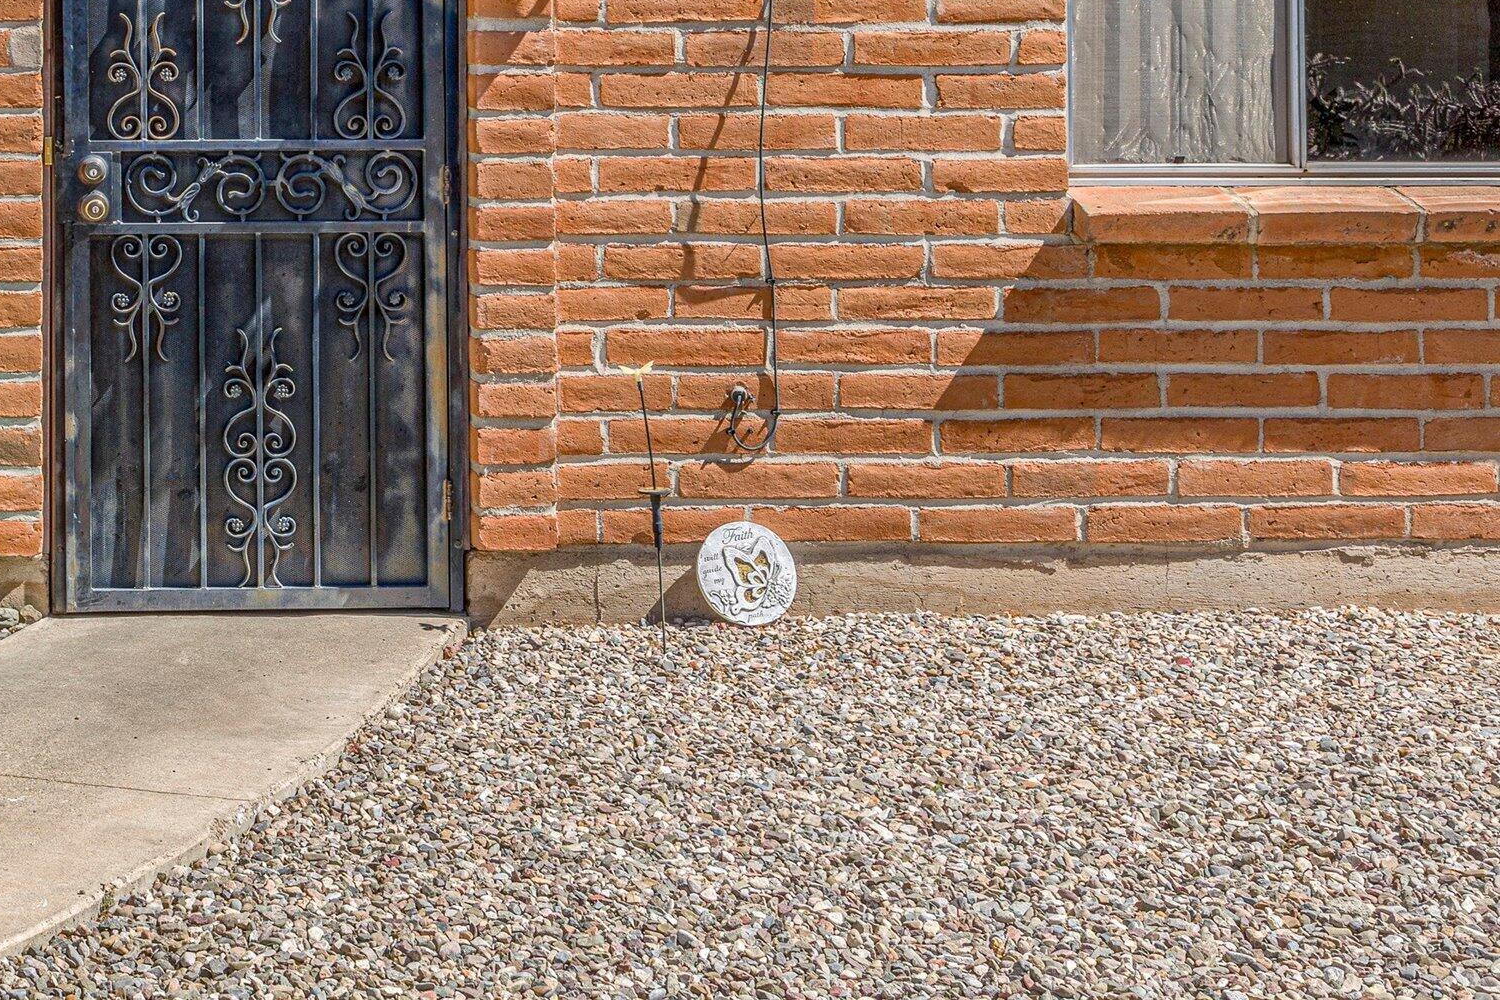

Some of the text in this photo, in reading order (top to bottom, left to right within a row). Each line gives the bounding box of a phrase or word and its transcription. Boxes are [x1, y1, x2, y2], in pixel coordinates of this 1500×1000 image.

[722, 526, 754, 545] Faith
[703, 552, 719, 563] will
[703, 564, 722, 579] guide
[713, 578, 725, 586] my
